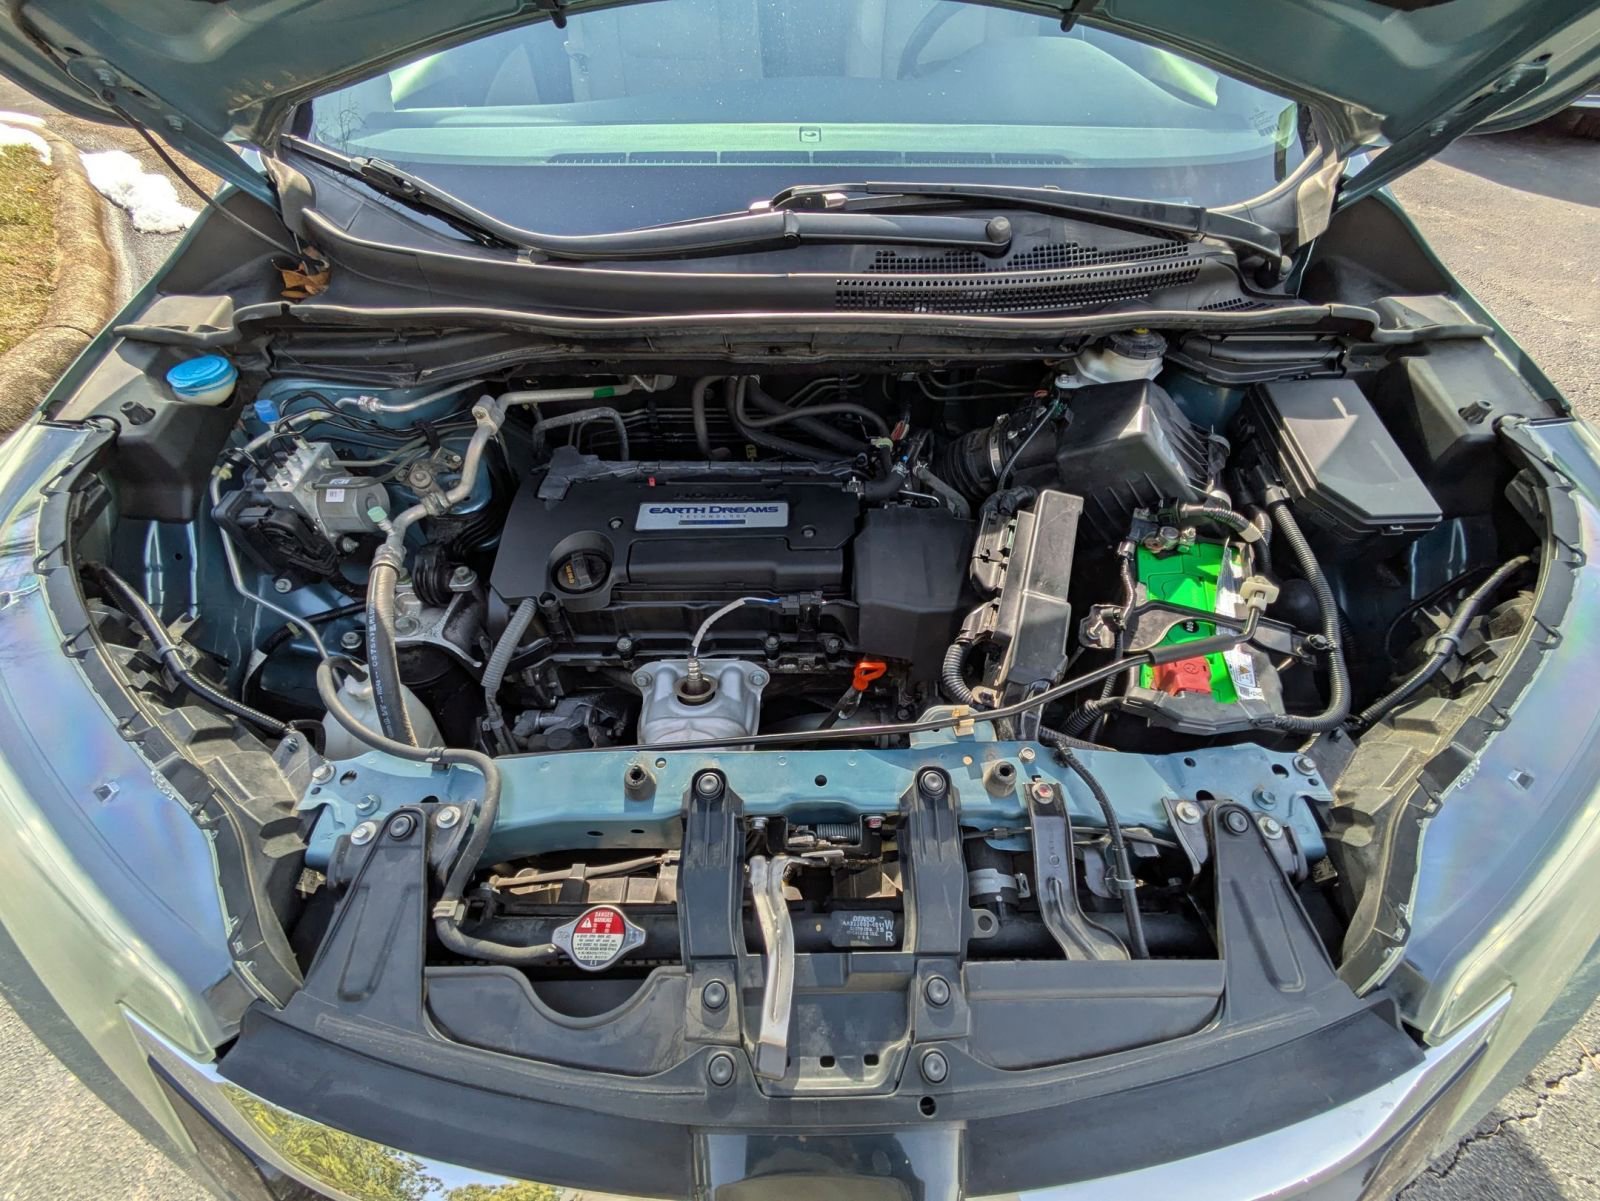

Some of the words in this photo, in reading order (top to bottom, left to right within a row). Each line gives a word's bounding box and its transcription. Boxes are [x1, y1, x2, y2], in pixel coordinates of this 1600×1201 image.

[852, 915, 876, 923] DENSO
[884, 919, 895, 931] W
[885, 930, 894, 942] R
